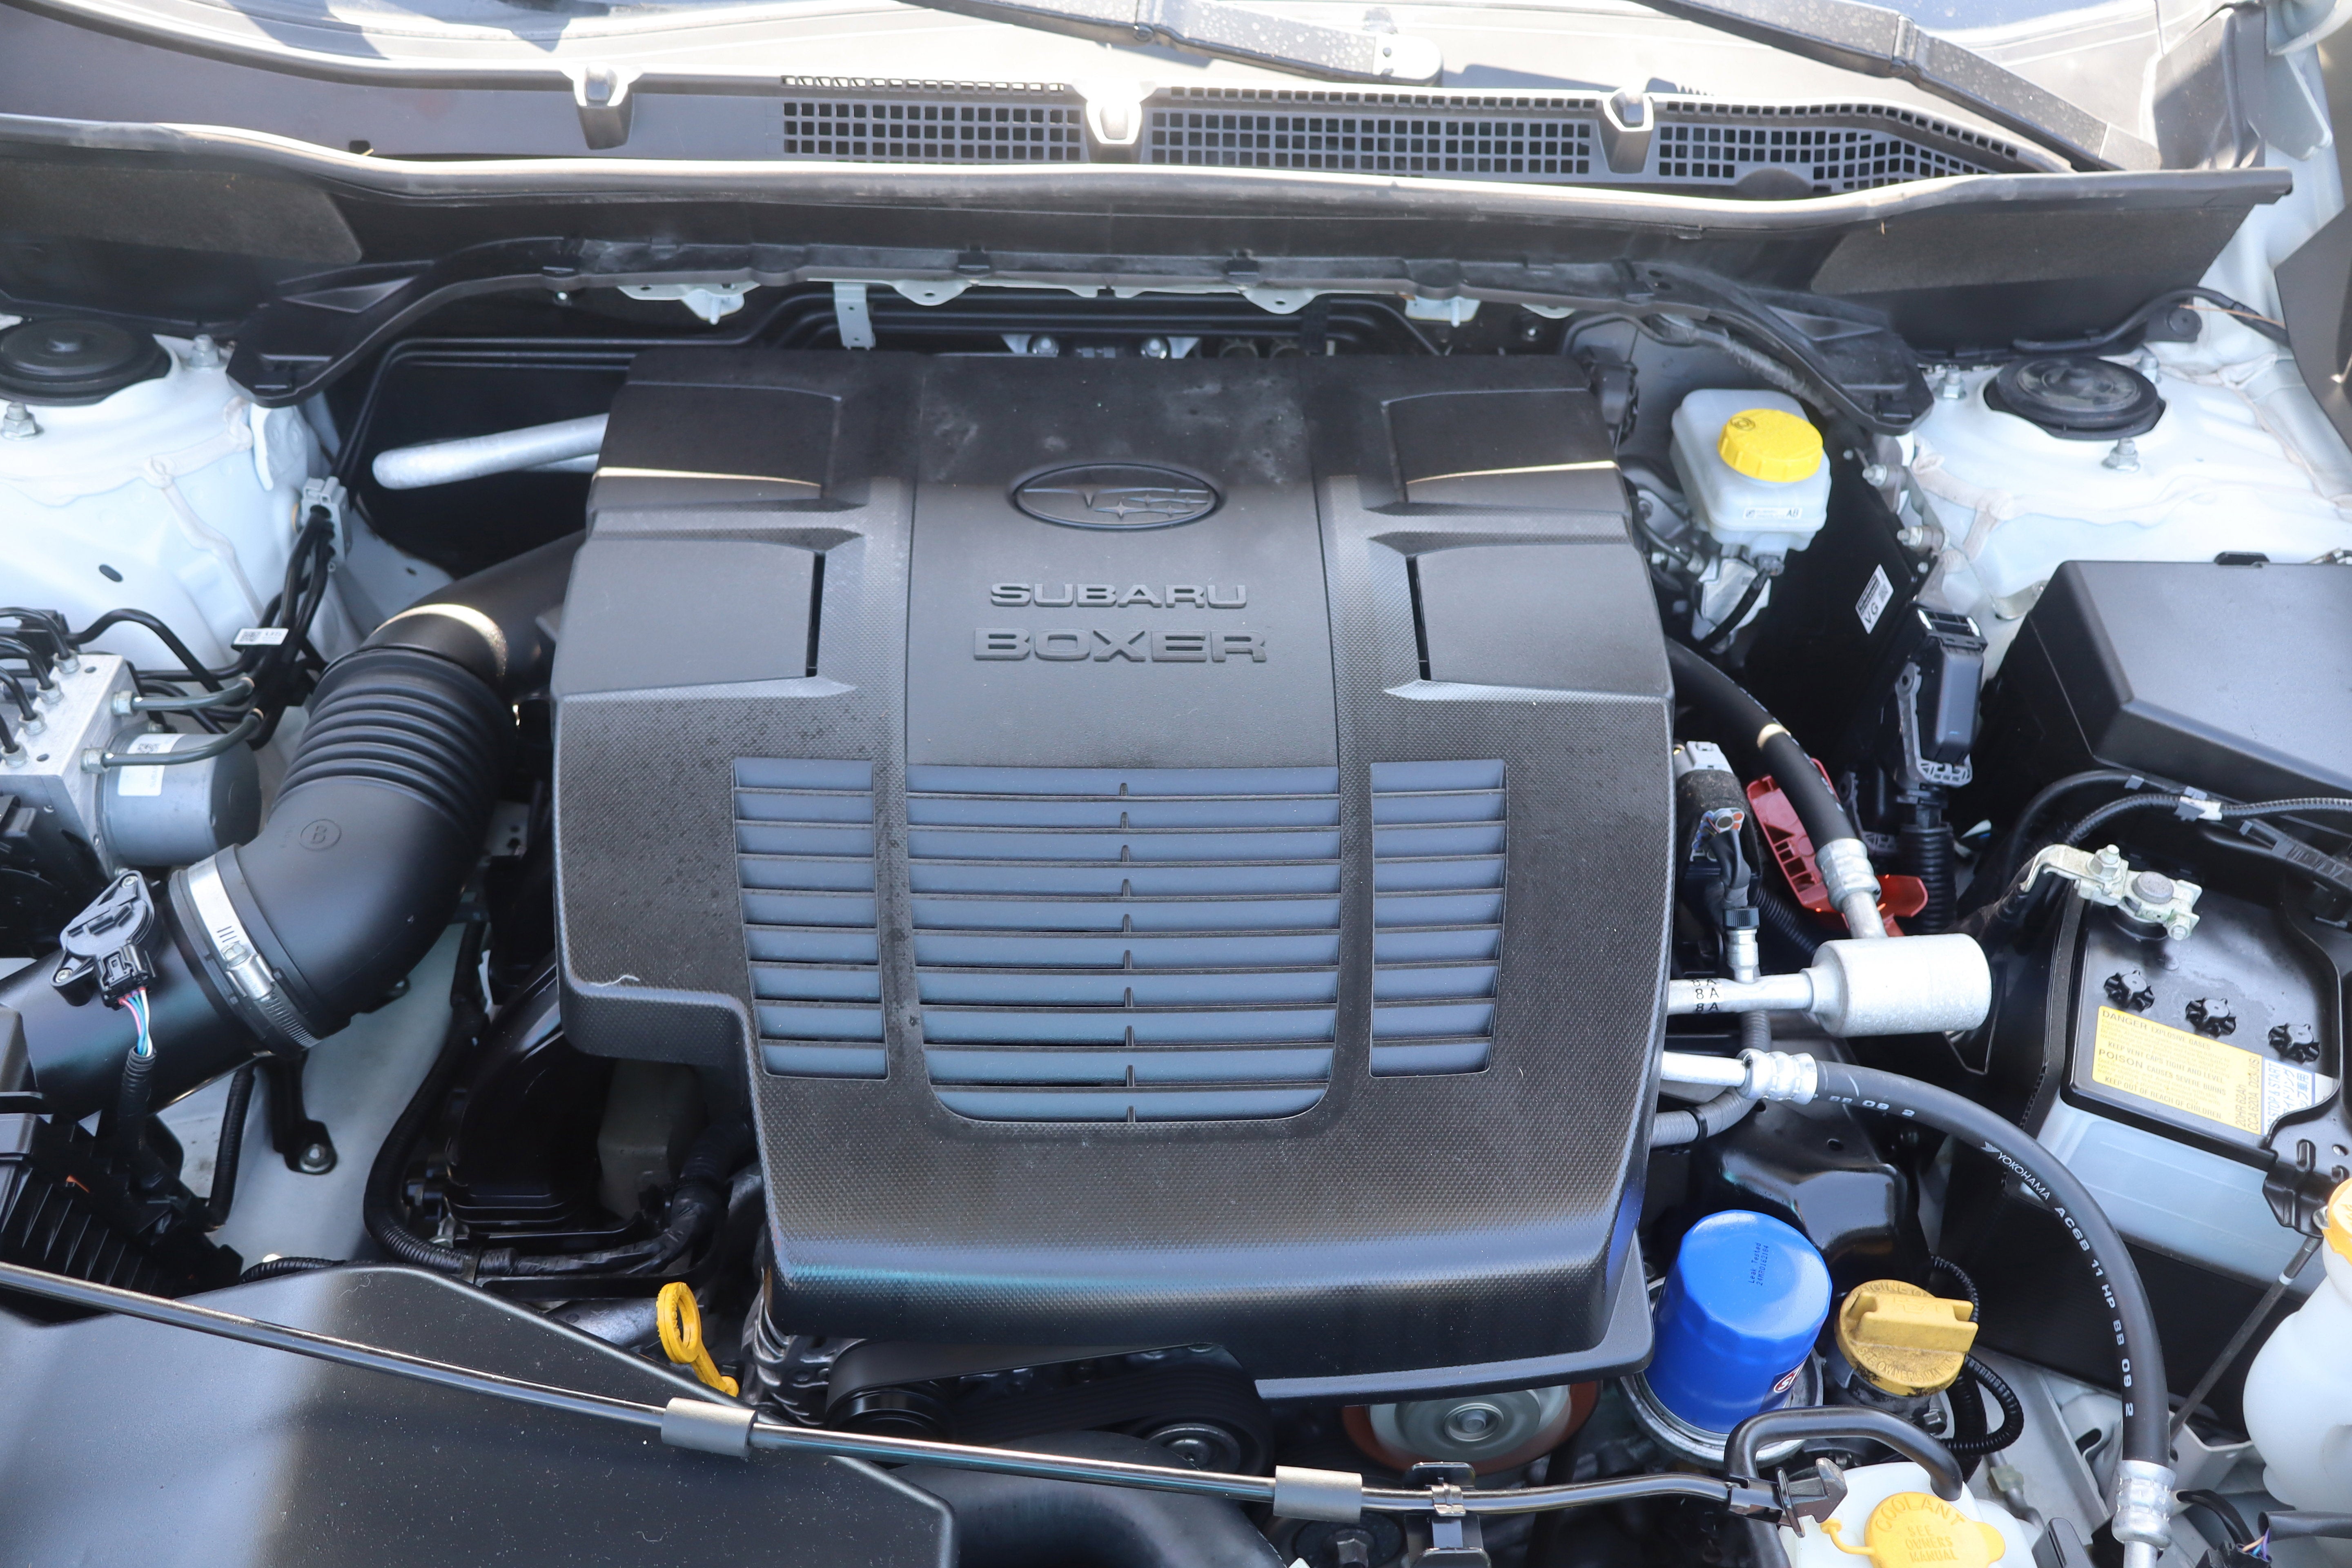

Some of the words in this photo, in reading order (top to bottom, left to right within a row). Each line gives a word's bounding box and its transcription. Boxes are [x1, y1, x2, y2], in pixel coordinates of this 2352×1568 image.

[990, 583, 1247, 608] SUBARU
[1864, 602, 1879, 624] VG
[973, 627, 1267, 663] BOXER
[1695, 988, 1704, 999] 8
[1710, 987, 1719, 998] A
[1695, 1003, 1704, 1012] 8
[1708, 1002, 1718, 1011] A
[2102, 1009, 2147, 1030] DANGER
[2098, 1048, 2143, 1069] POISON
[2268, 1062, 2281, 1089] START
[1862, 1100, 1890, 1110] 09
[1901, 1109, 1915, 1117] 2
[2248, 1092, 2259, 1111] 620A
[2268, 1096, 2280, 1117] STOP
[2248, 1113, 2258, 1130] CCA
[1998, 1152, 2050, 1200] YOKOHAMA
[2054, 1207, 2090, 1251] AC6B
[1751, 1242, 1761, 1263] Tested
[1748, 1269, 1756, 1283] Leak
[2091, 1259, 2103, 1276] 11
[2102, 1284, 2116, 1308] HP
[2113, 1319, 2125, 1346] BB
[1858, 1347, 1877, 1365] SEE
[1878, 1361, 1924, 1382] OWNER'S
[2122, 1358, 2132, 1387] 09
[2125, 1402, 2134, 1417] 2
[1876, 1496, 1965, 1532] COOLANT
[1908, 1525, 1934, 1537] SEE
[1906, 1536, 1953, 1550] OWNERS
[1910, 1548, 1959, 1563] MANUAL
